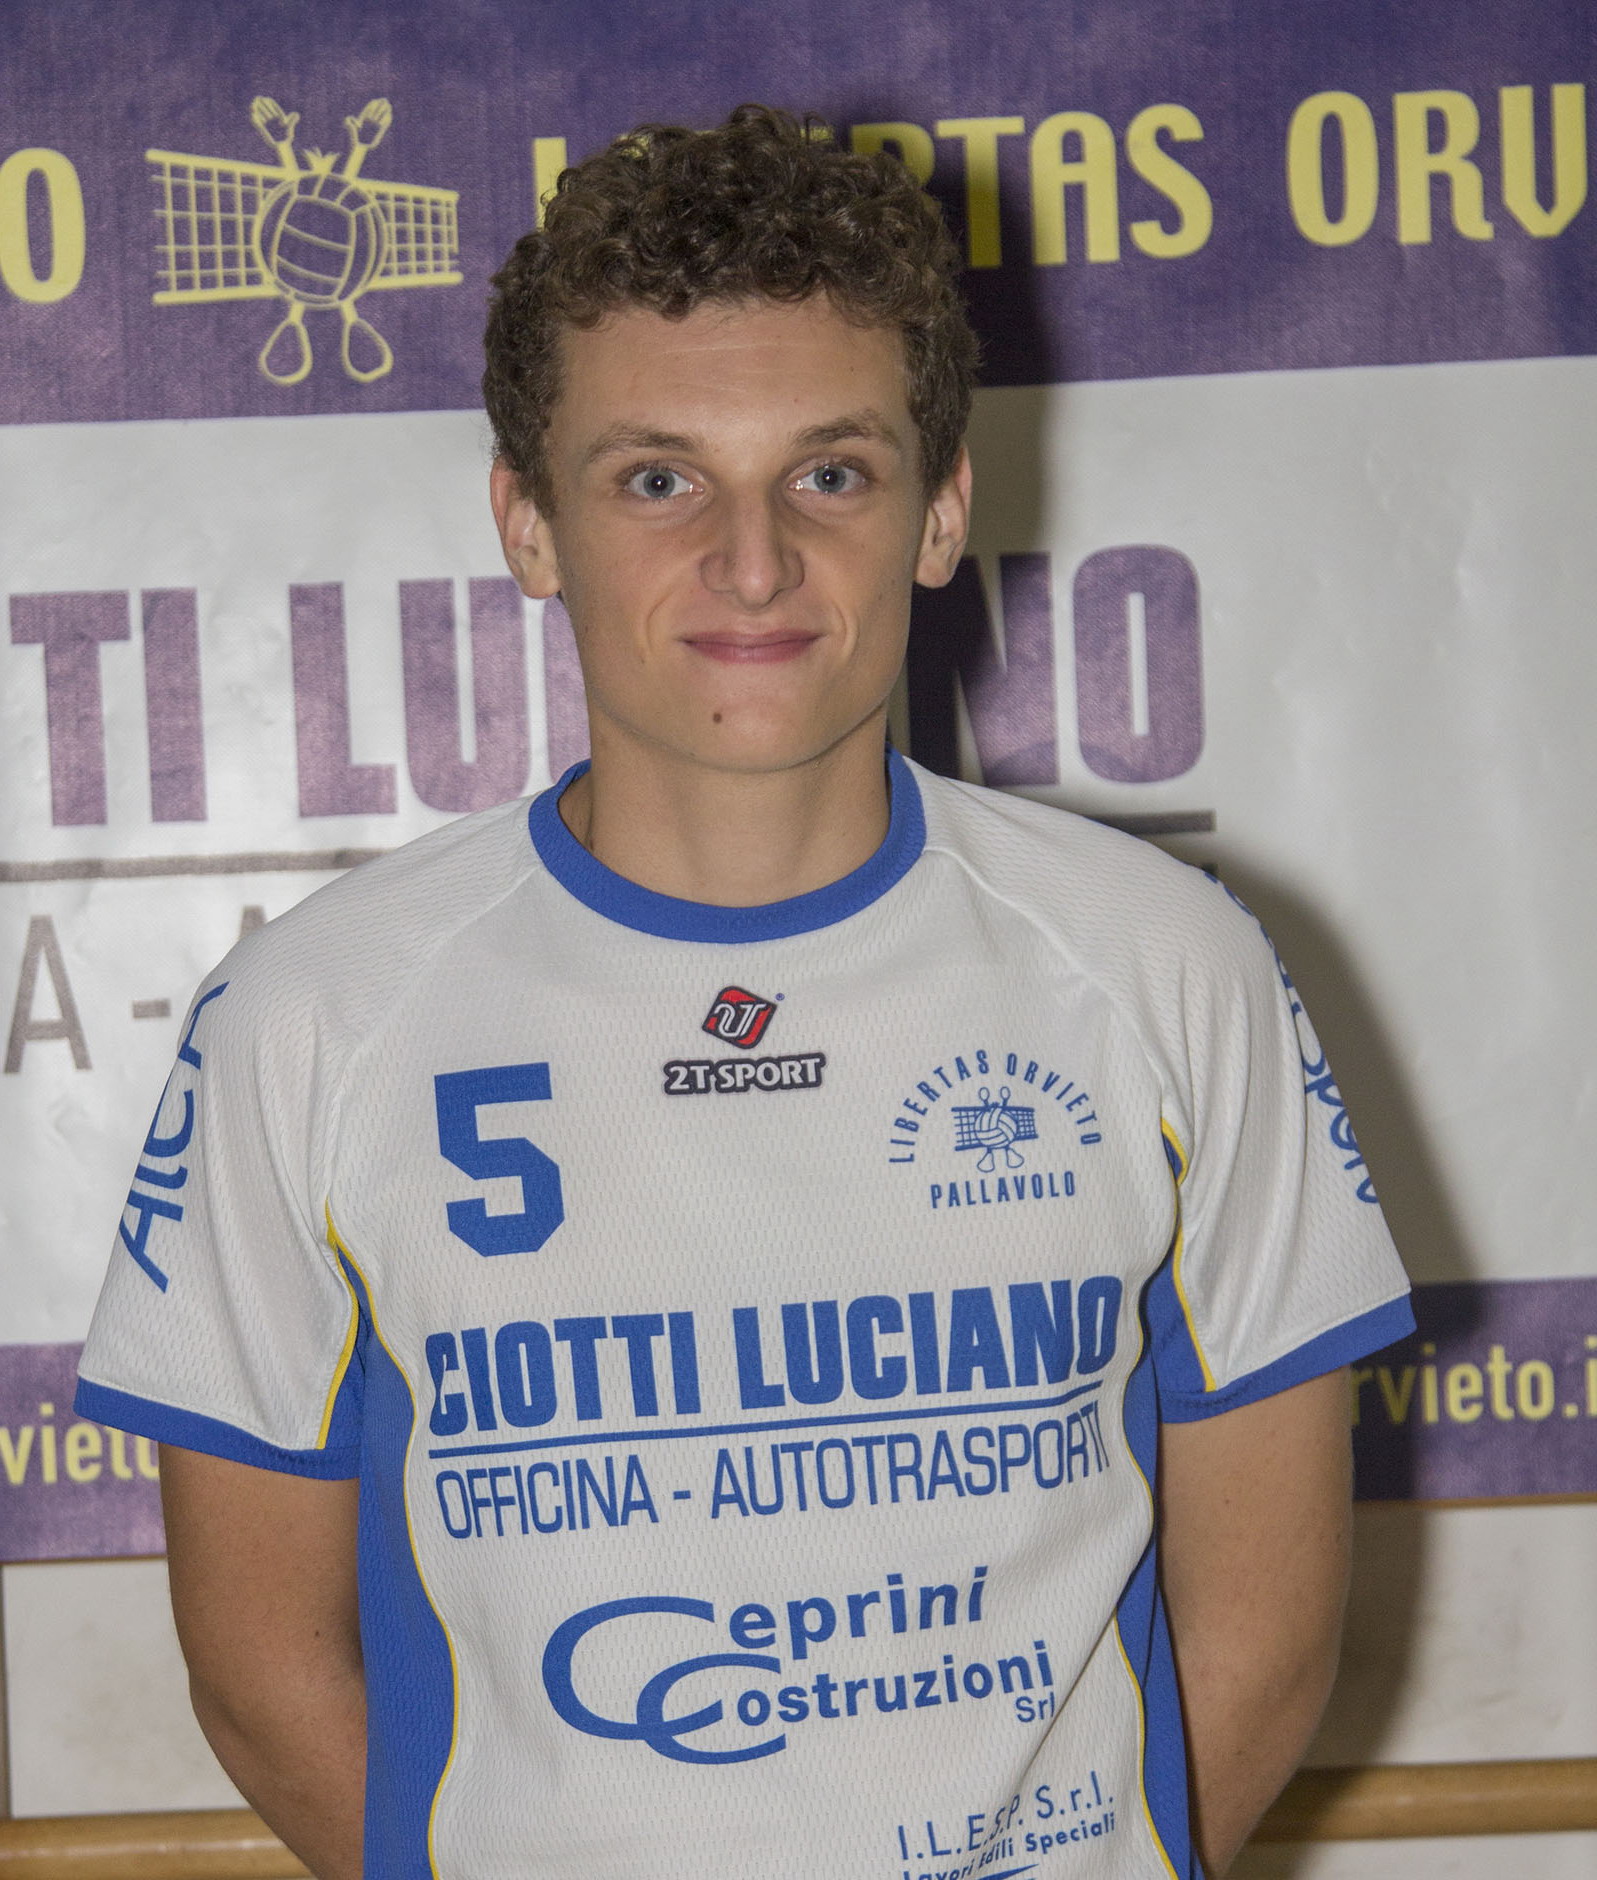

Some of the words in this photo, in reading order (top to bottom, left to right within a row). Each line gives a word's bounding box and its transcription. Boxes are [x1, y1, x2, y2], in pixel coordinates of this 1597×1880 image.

[10, 586, 208, 827] TI
[716, 1056, 823, 1090] SPORT
[889, 1050, 990, 1163] LIBERTAS
[1006, 1053, 1103, 1146] ORVIETO
[434, 1061, 565, 1258] 5
[930, 1171, 1076, 1209] PALLAVOLO
[425, 1310, 702, 1438] CIOTTI
[732, 1275, 1123, 1410] LUCIANO
[436, 1453, 659, 1540] OFFICINA
[711, 1400, 1110, 1520] AUTOTRASPORTI
[542, 1565, 989, 1740] Ceprini
[636, 1640, 1056, 1765] Costruzioni
[1016, 1692, 1056, 1725] Srl
[1025, 1812, 1115, 1854] Speciali
